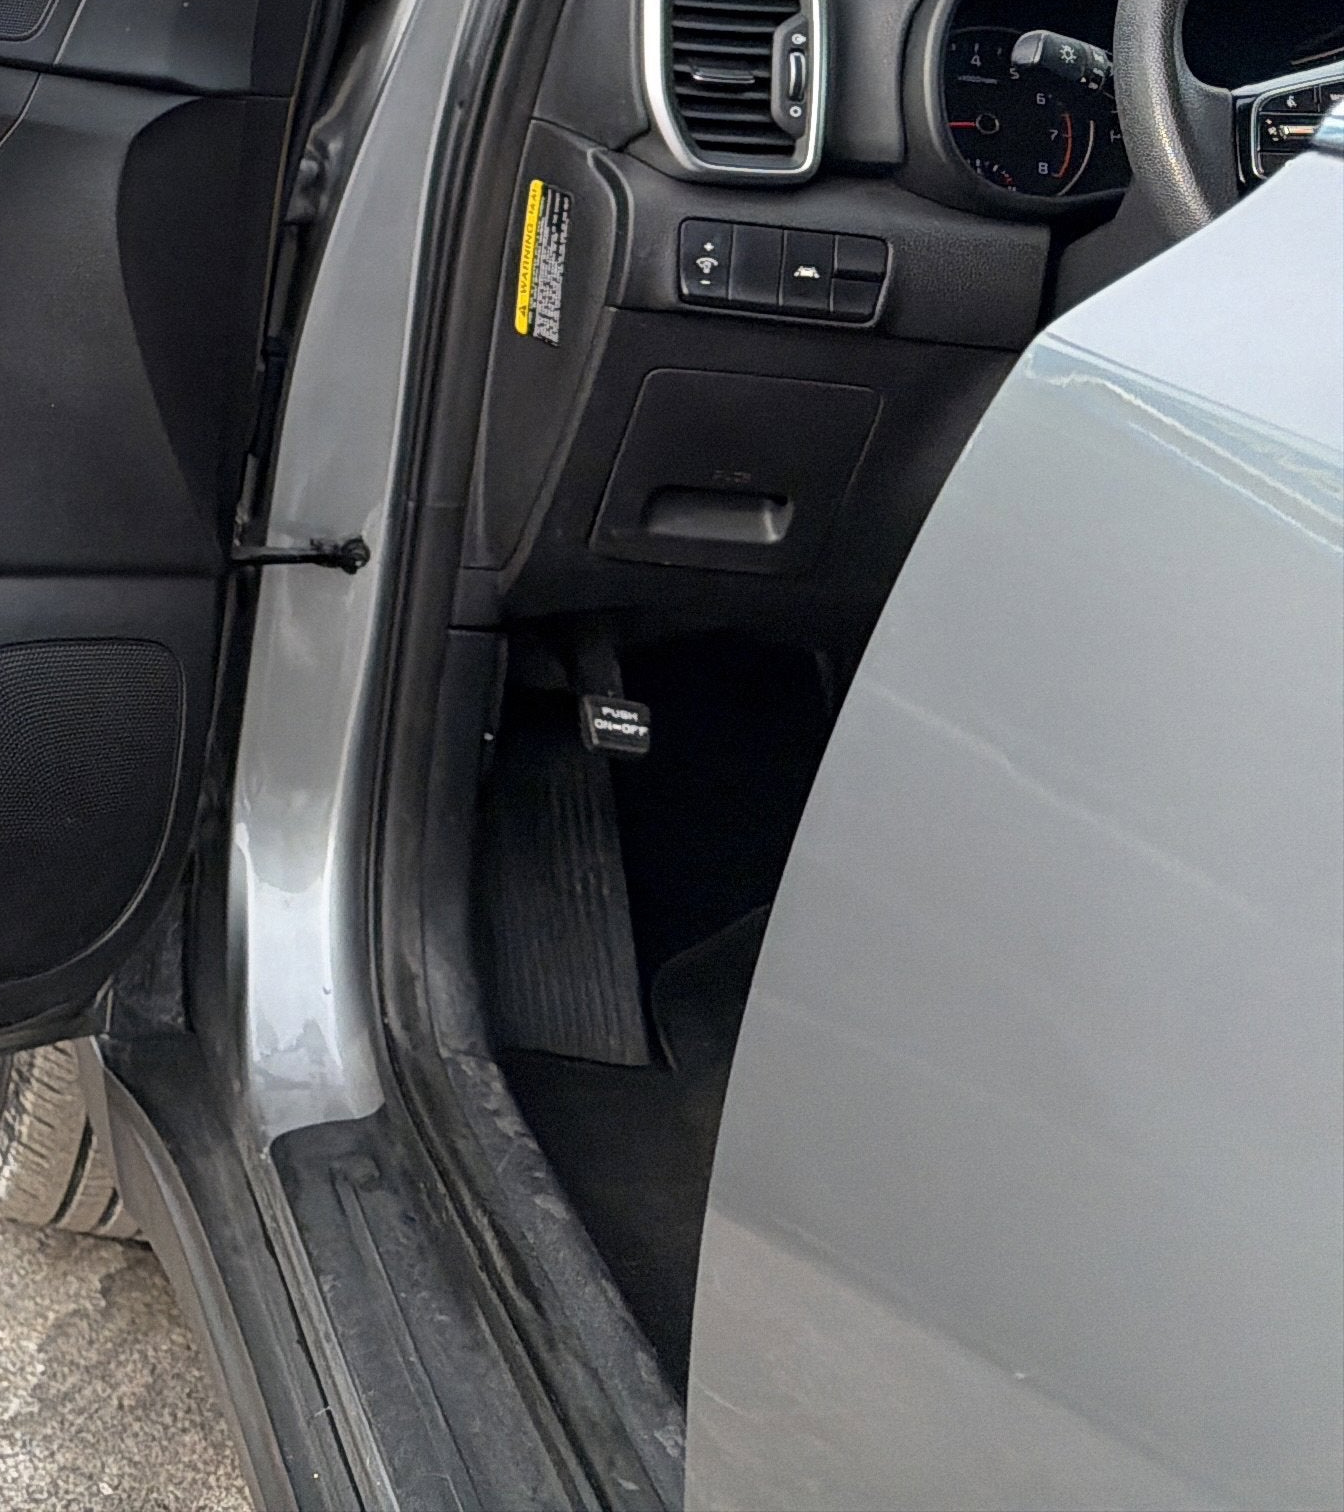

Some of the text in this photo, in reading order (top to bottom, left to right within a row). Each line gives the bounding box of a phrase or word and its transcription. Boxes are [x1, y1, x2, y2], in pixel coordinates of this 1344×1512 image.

[970, 55, 981, 67] 4
[1009, 68, 1020, 80] 5
[1036, 93, 1046, 105] 6
[1049, 129, 1059, 141] 7
[1038, 162, 1049, 175] 8
[520, 223, 533, 293] WARNING
[601, 706, 639, 722] PUSH
